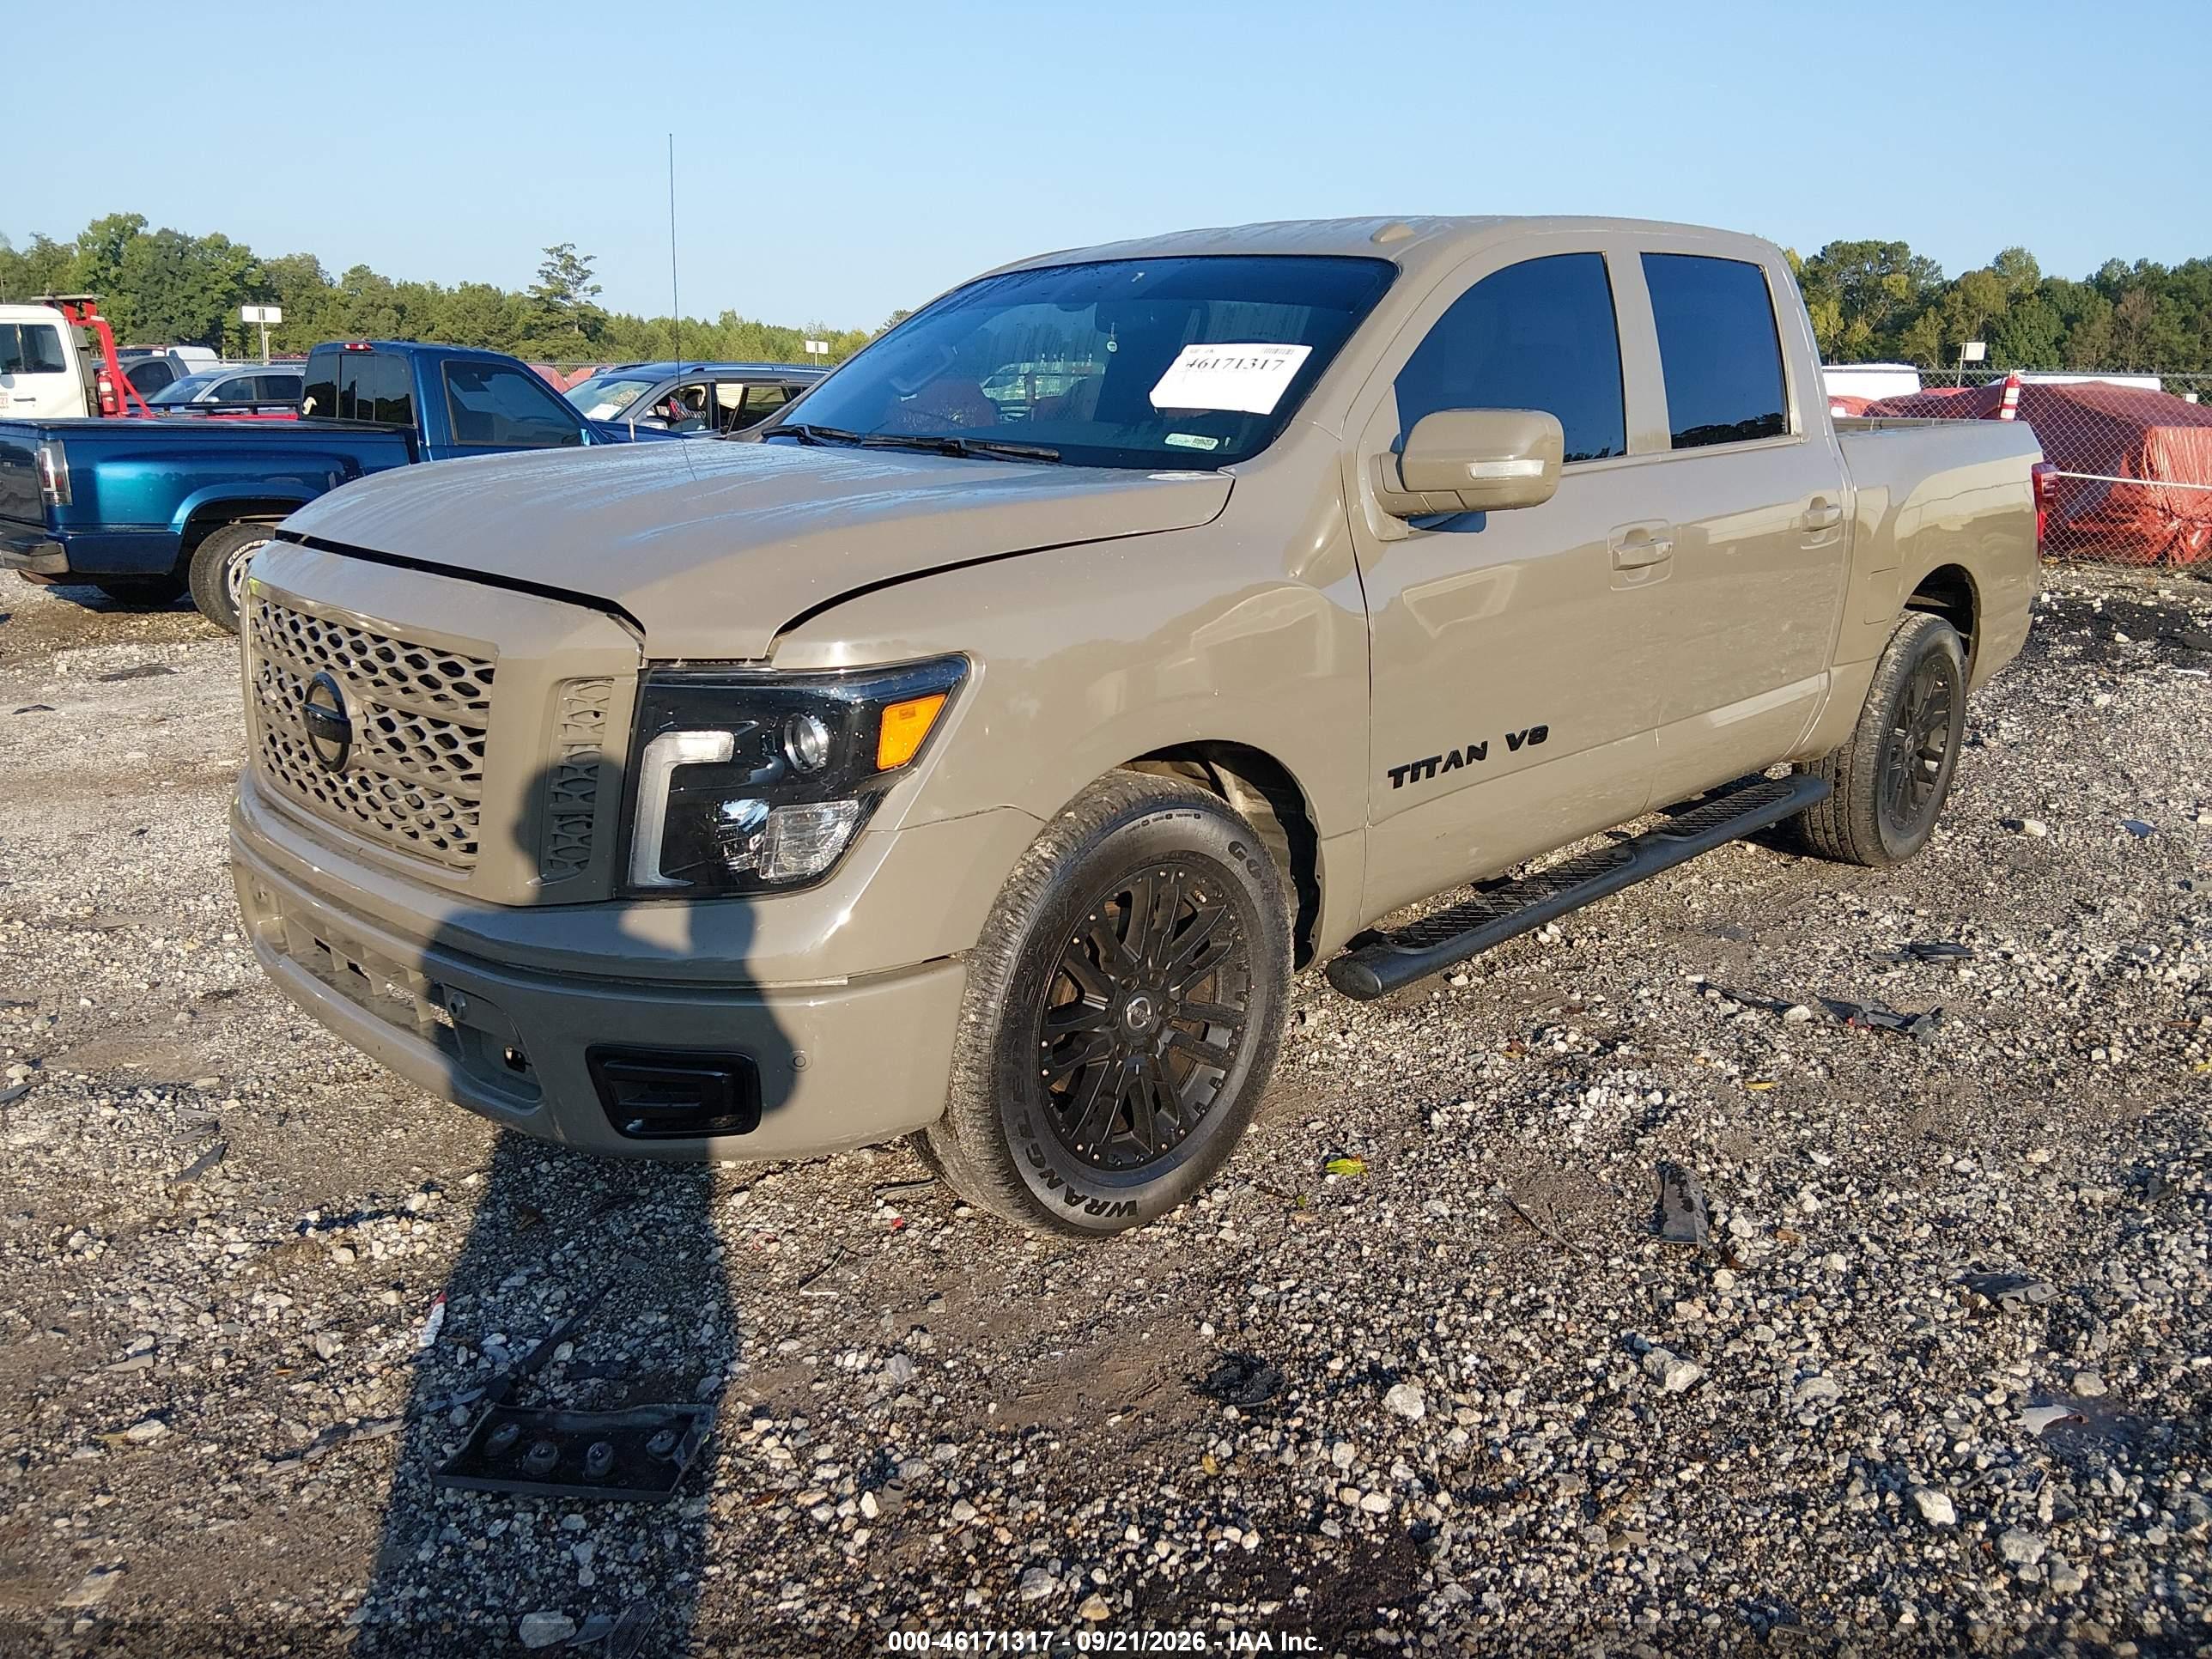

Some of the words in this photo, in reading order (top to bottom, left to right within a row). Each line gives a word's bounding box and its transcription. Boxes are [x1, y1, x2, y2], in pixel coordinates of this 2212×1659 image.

[1185, 358, 1285, 371] 46171317
[1387, 740, 1489, 789] TITAN
[1504, 725, 1549, 752] V8
